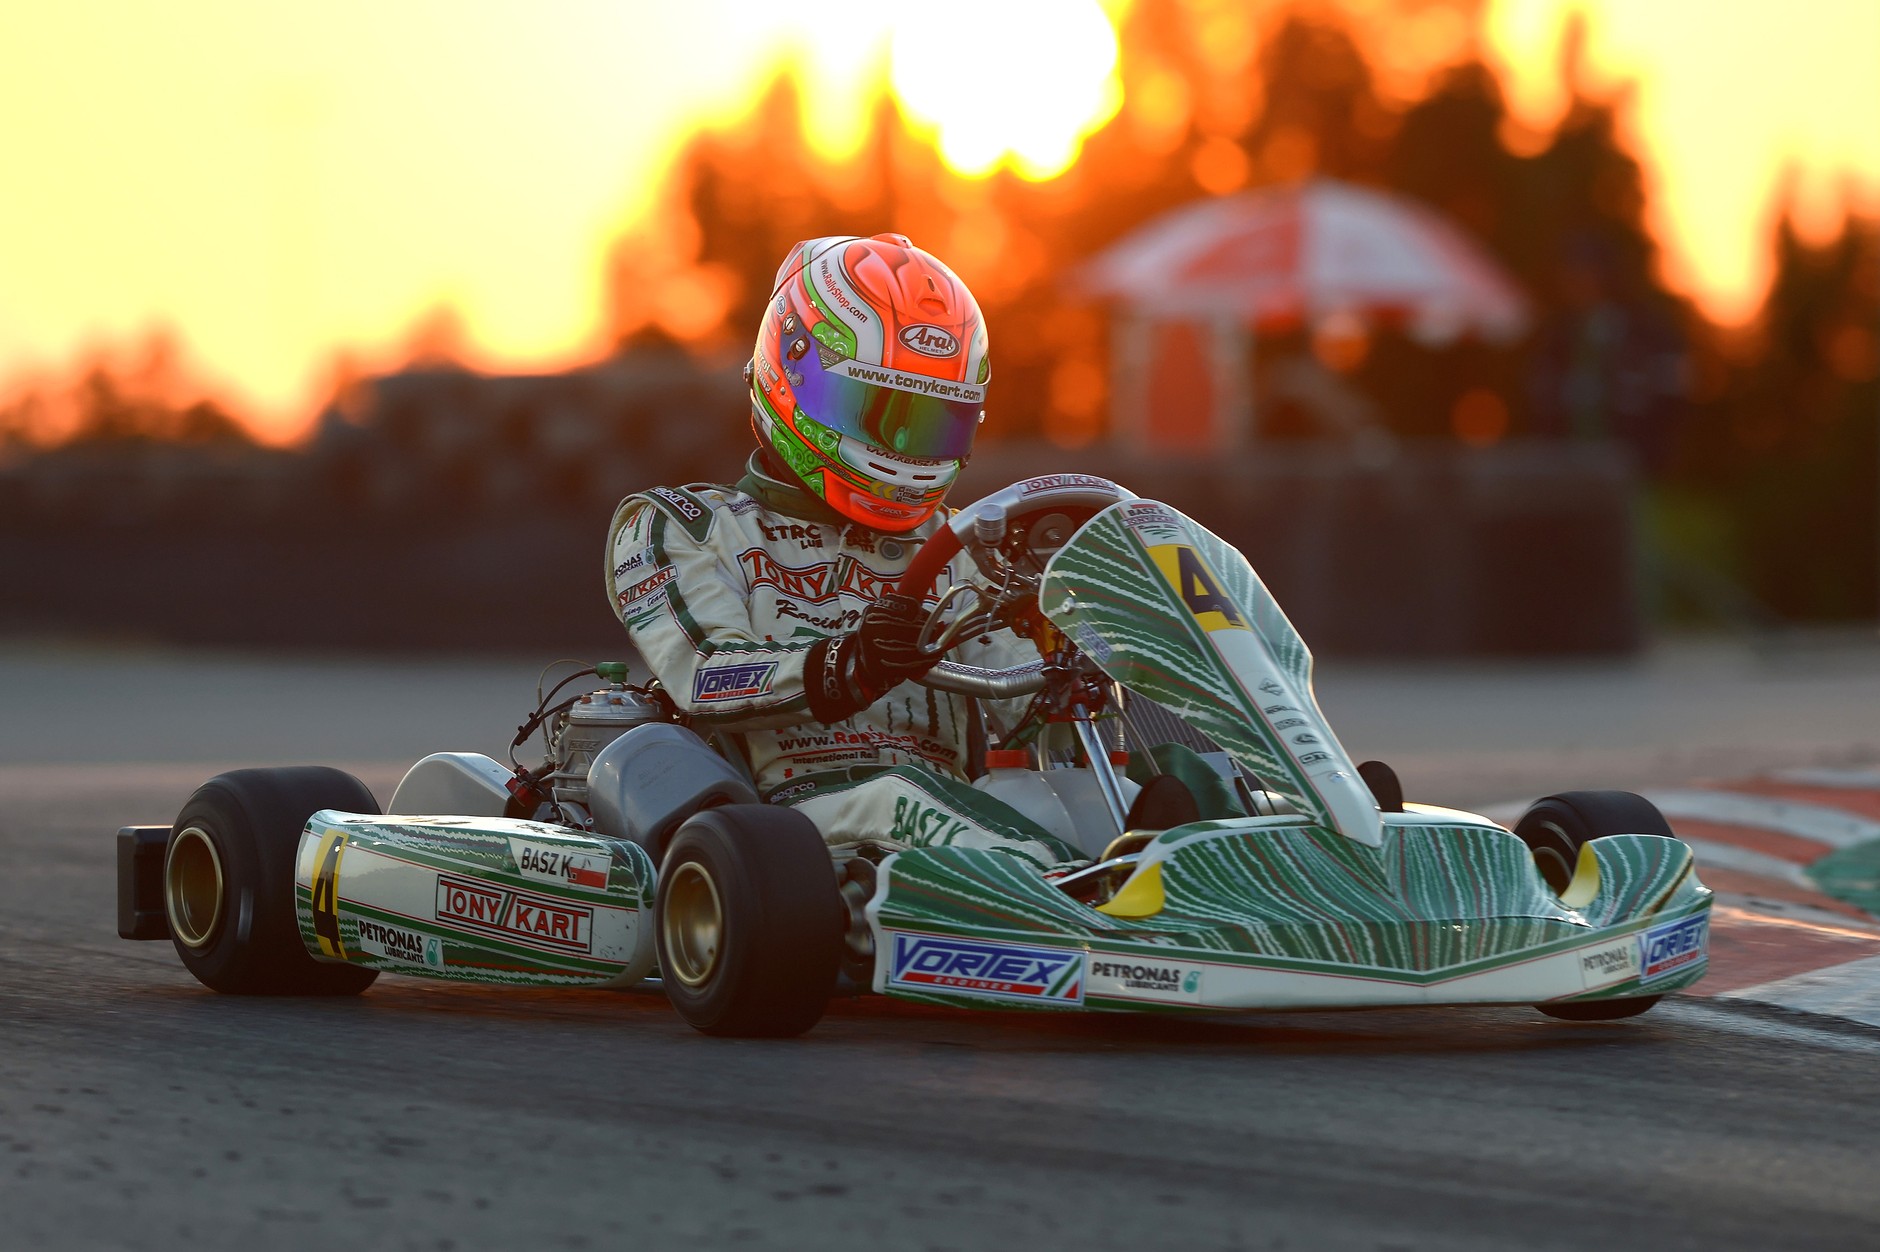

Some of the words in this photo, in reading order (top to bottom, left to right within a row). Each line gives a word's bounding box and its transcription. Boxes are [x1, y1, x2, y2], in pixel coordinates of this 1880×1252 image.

[905, 327, 953, 351] Arai
[847, 366, 981, 401] www.tonykart.com
[743, 550, 828, 597] TONY
[857, 566, 948, 600] KAT
[1177, 546, 1245, 627] 4
[696, 665, 770, 699] VORTEX
[520, 847, 557, 875] BASZ
[312, 835, 345, 957] 4
[439, 880, 502, 923] TONY
[516, 899, 589, 941] KART
[358, 920, 423, 953] PETRONAS
[384, 945, 425, 965] LUBRICANTS
[899, 937, 1072, 985] VORTEX
[933, 975, 1013, 991] ENGINES
[1092, 961, 1180, 983] PETRONAS
[1126, 979, 1179, 992] LUBRICANTS
